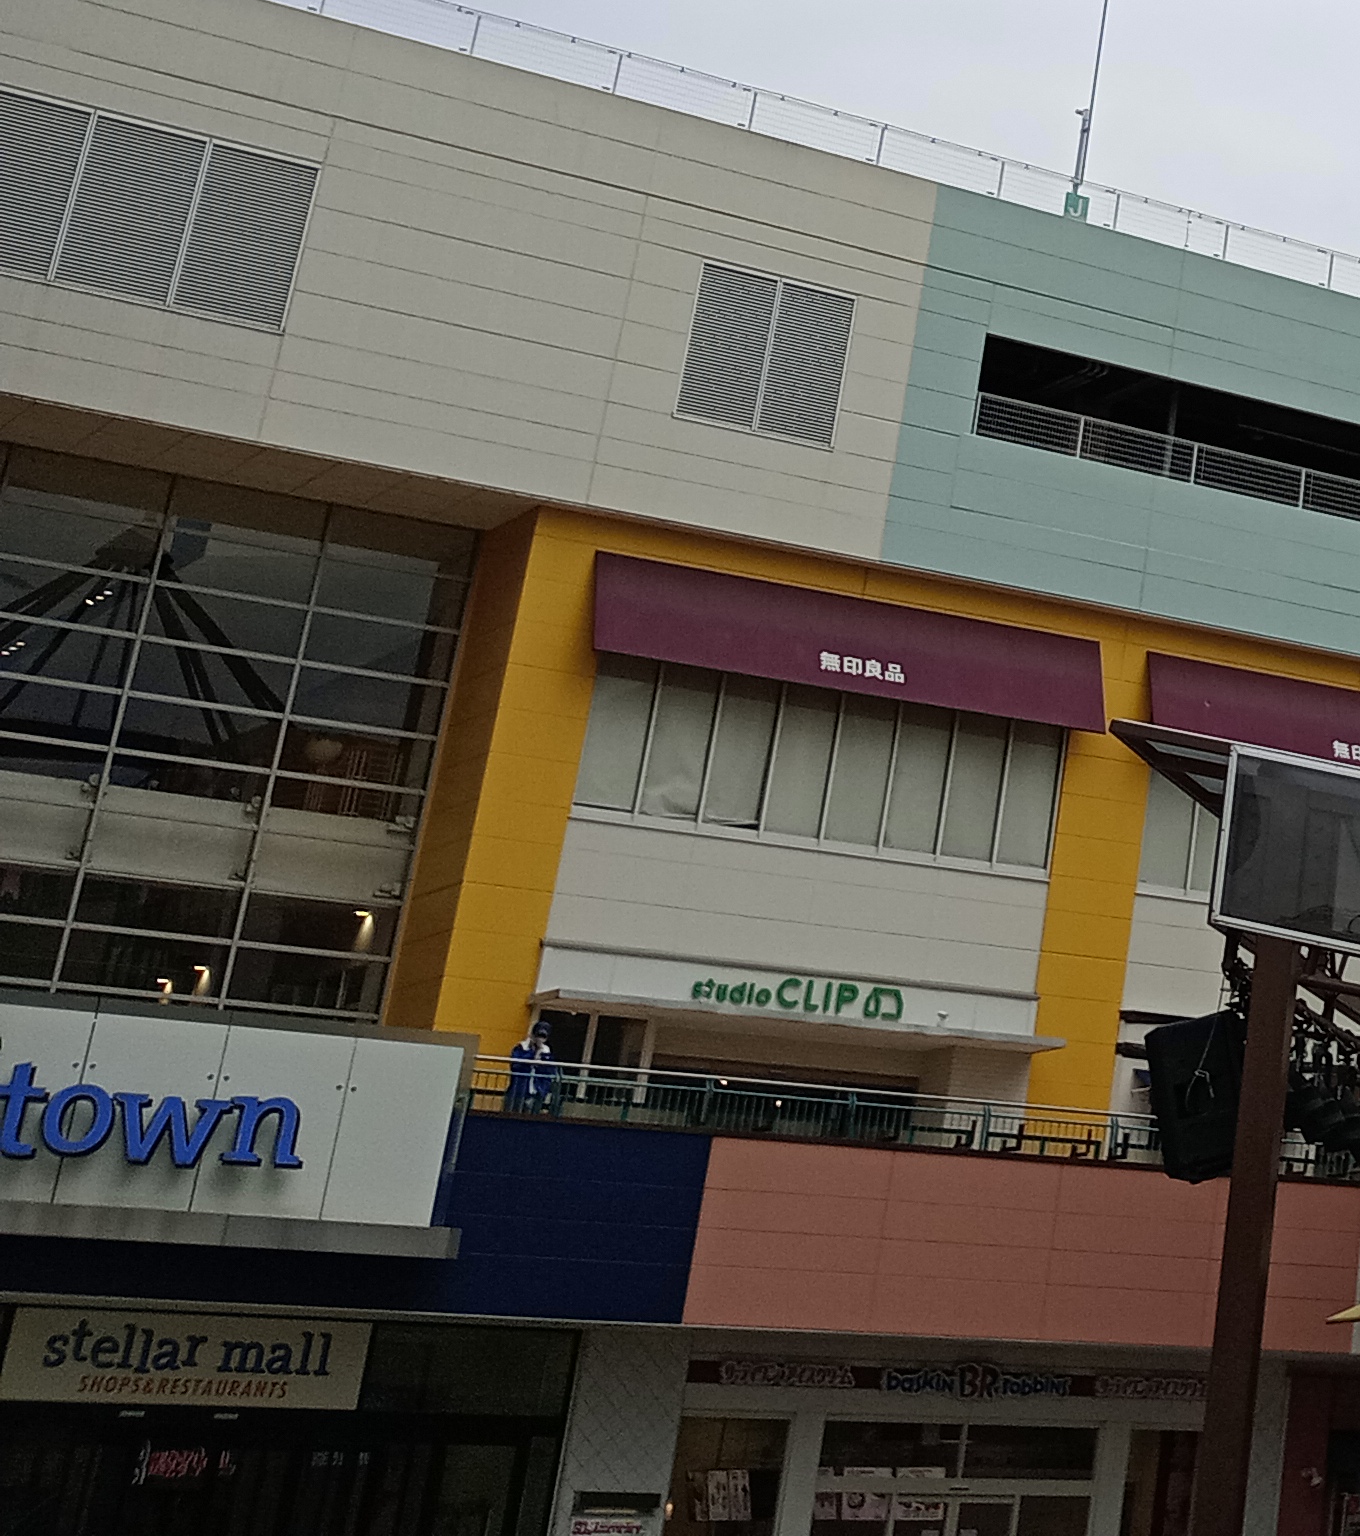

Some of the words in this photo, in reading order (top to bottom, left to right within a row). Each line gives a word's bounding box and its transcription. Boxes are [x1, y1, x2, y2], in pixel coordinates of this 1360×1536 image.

[819, 651, 905, 684] 無印良品
[776, 977, 860, 1015] CLIP
[0, 1061, 303, 1169] town
[43, 1318, 207, 1374] stellar
[217, 1330, 333, 1376] mall
[77, 1375, 288, 1399] SHOPS&RESTAURANTS
[887, 1371, 954, 1394] baskin
